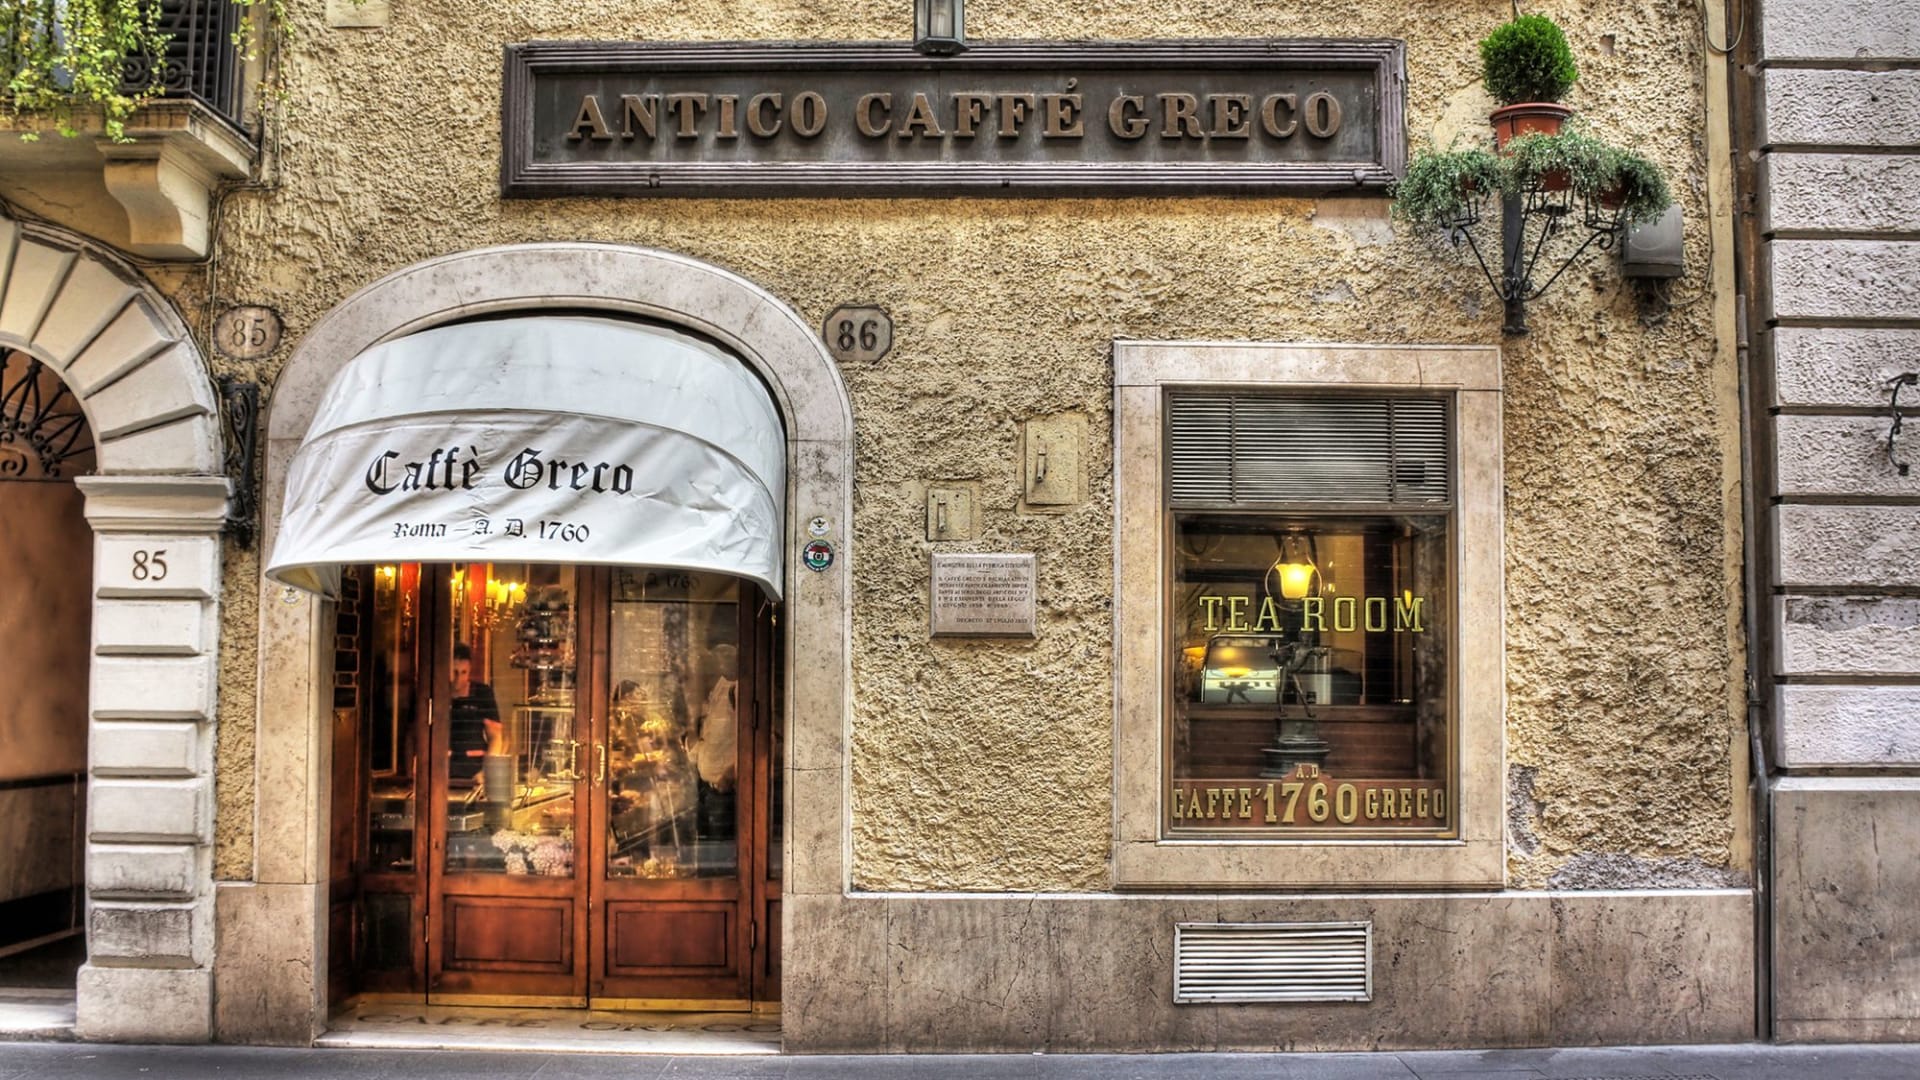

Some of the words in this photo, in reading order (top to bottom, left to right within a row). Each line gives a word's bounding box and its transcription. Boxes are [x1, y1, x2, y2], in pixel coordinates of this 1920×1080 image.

[567, 91, 828, 139] ANTICO
[855, 77, 1084, 138] CAFFÉ
[1107, 90, 1342, 139] GRECO
[232, 319, 266, 347] 85
[838, 319, 878, 351] 86
[365, 446, 481, 495] Caffè
[503, 447, 634, 495] Greco
[392, 522, 447, 539] Roma
[538, 520, 590, 543] 1760
[132, 549, 168, 581] 85
[1199, 596, 1283, 632] TEA
[1300, 596, 1424, 632] ROOM
[1263, 782, 1358, 824] 1760
